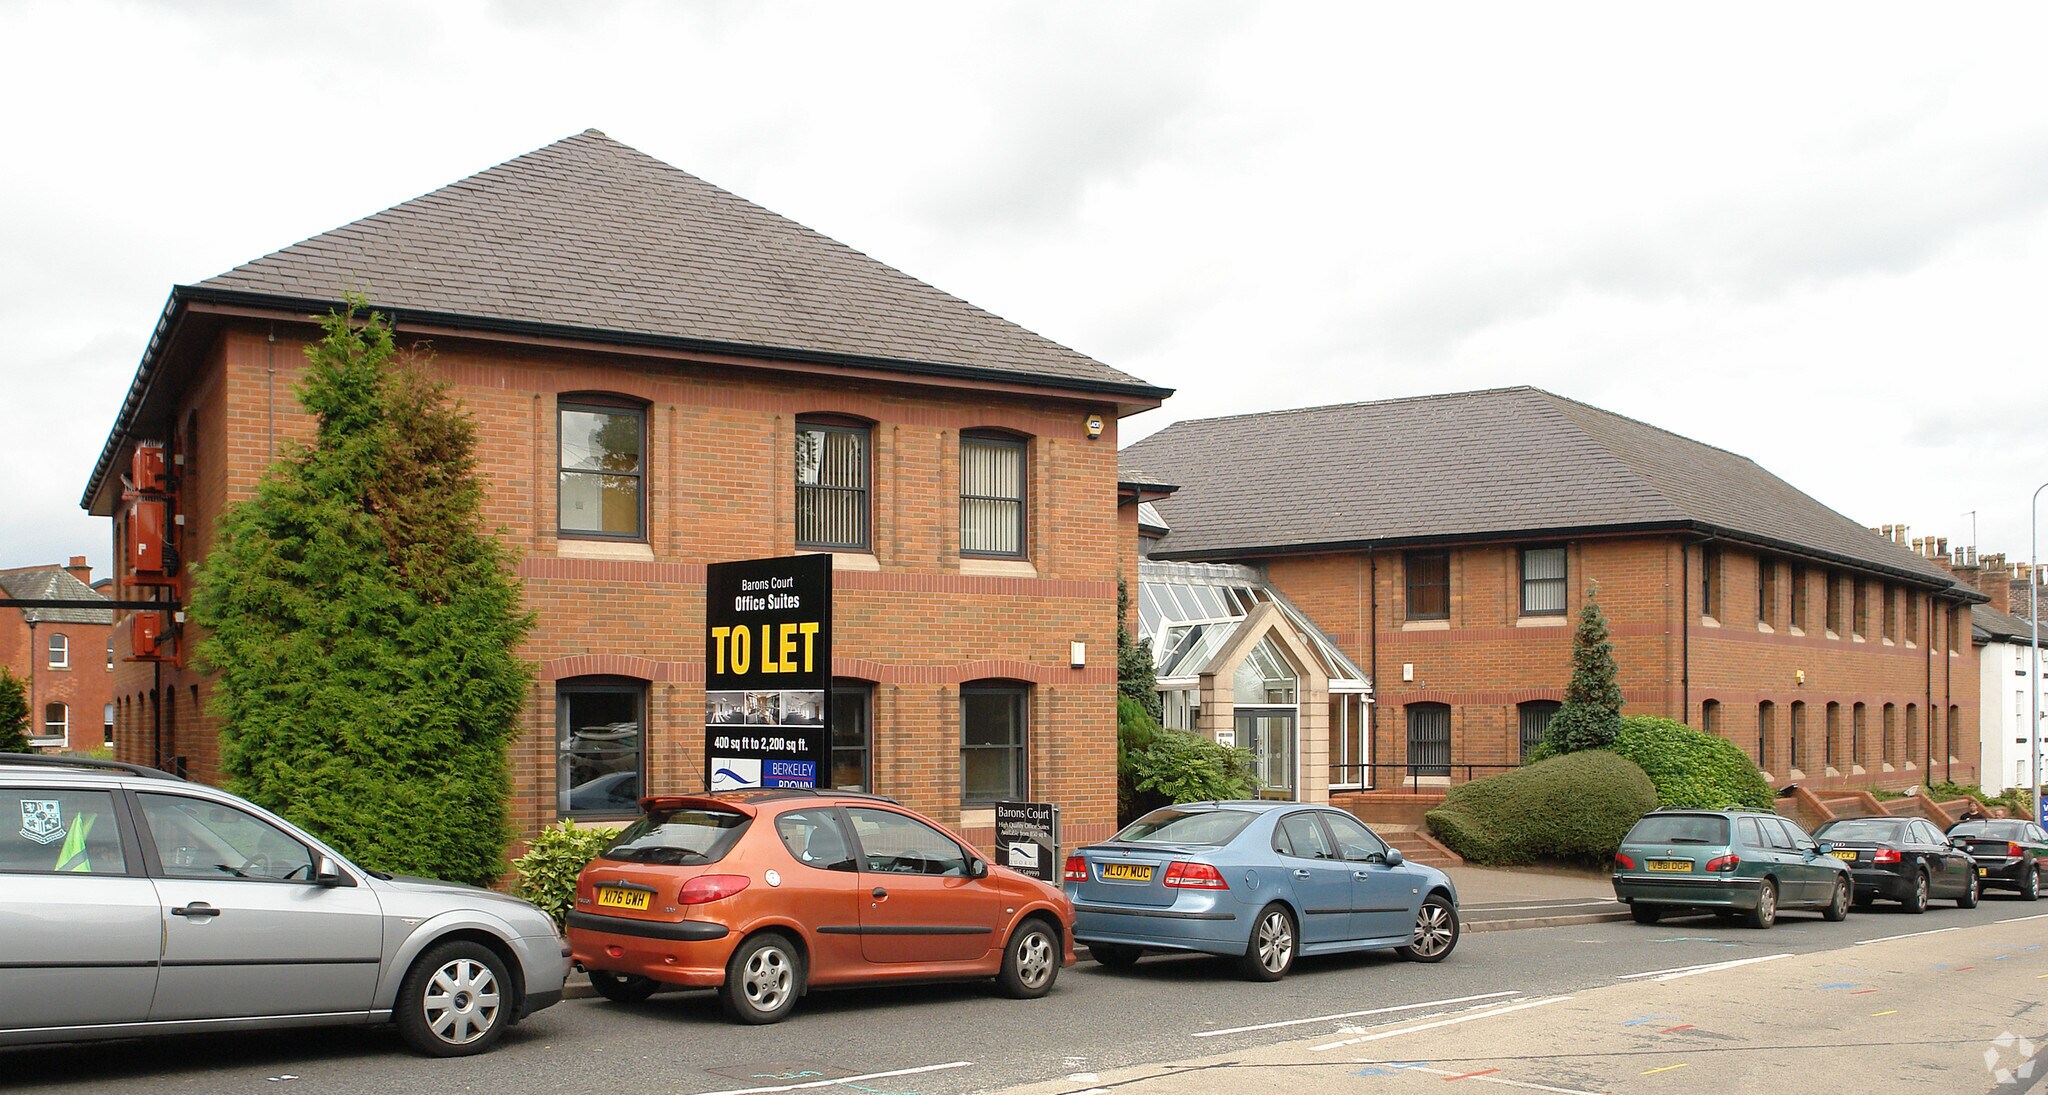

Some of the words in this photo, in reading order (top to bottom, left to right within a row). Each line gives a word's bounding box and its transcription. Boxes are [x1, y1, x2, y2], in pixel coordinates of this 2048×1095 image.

[742, 579, 769, 591] Barons
[771, 576, 794, 589] Court
[735, 595, 766, 612] Office
[767, 593, 800, 610] Suites
[711, 624, 751, 675] TO
[761, 622, 819, 673] LET
[714, 736, 729, 749] 400
[730, 739, 740, 752] sq
[742, 737, 749, 750] ft
[751, 737, 759, 750] to
[761, 737, 785, 752] 2,200
[786, 740, 796, 753] sq
[798, 738, 808, 752] ft.
[772, 762, 813, 776] BERKELEY
[998, 806, 1025, 818] Barons
[1026, 807, 1049, 819] Court
[1104, 864, 1129, 876] ML07
[1130, 865, 1150, 878] MUC
[603, 889, 623, 902] X176
[625, 890, 645, 906] GWH
